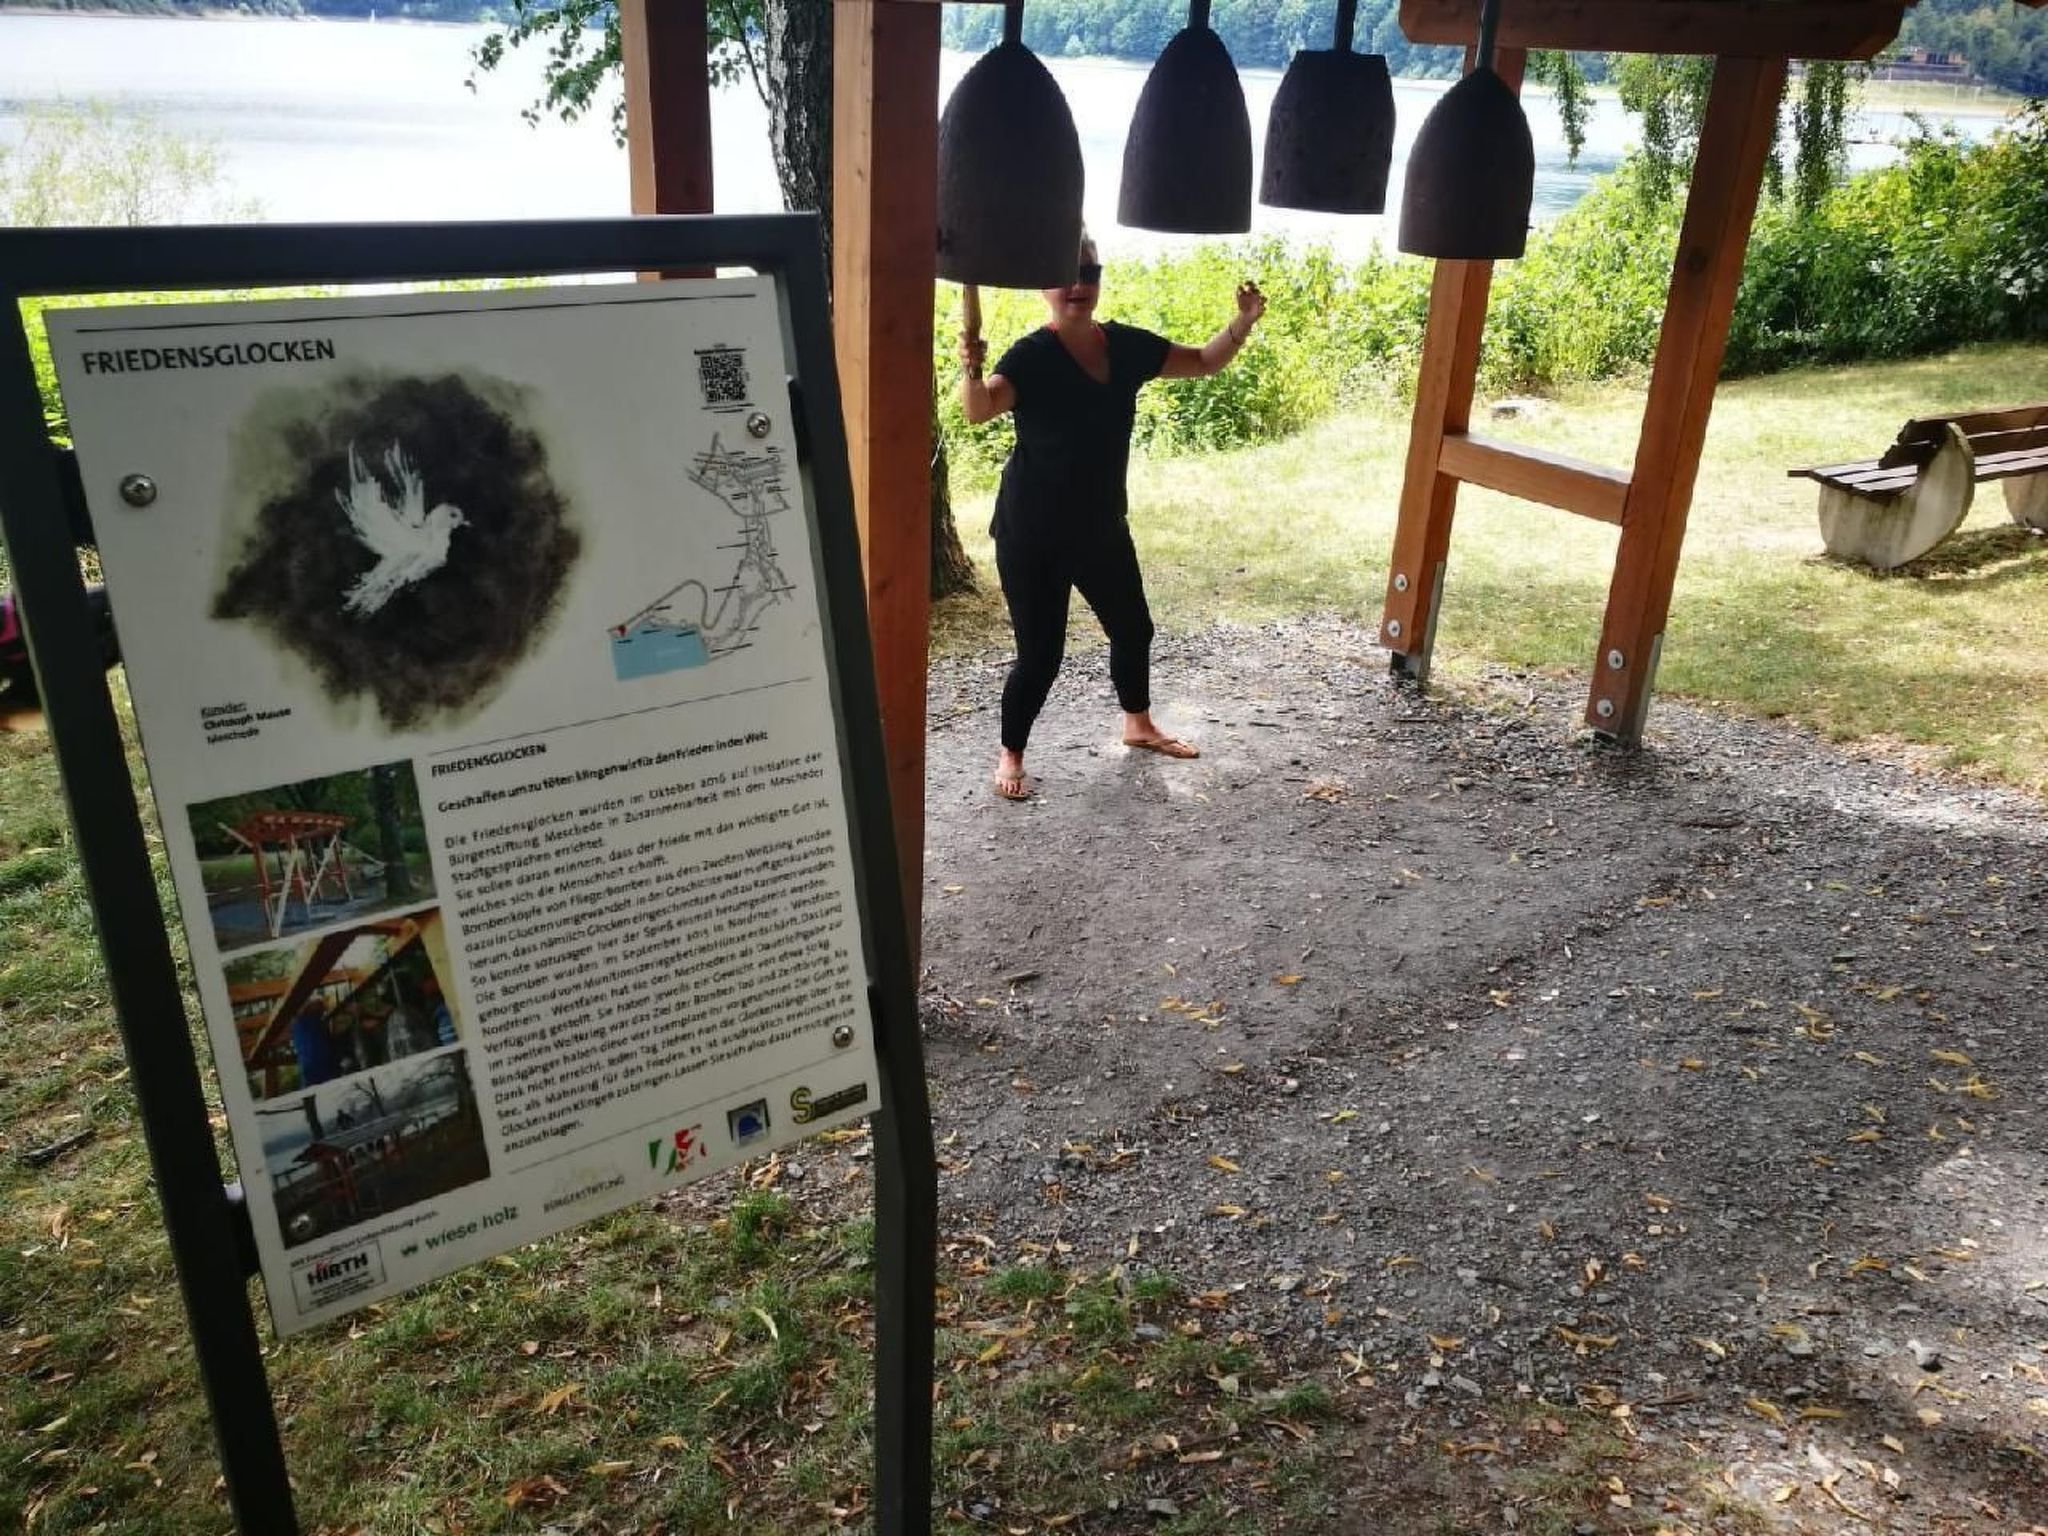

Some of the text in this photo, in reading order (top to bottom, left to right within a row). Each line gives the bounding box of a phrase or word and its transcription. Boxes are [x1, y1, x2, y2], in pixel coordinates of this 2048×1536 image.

[81, 338, 336, 375] FRIEDENSGLOCKEN
[430, 742, 547, 777] FRIEDENSGLOCKEN
[437, 789, 506, 812] Geschaffen
[448, 836, 539, 865] Bürgerstiftung
[544, 820, 603, 842] Meschede
[472, 810, 573, 842] Friedensglocken
[559, 865, 624, 892] Menschheit
[425, 1220, 478, 1250] wiese
[483, 1205, 519, 1230] holz
